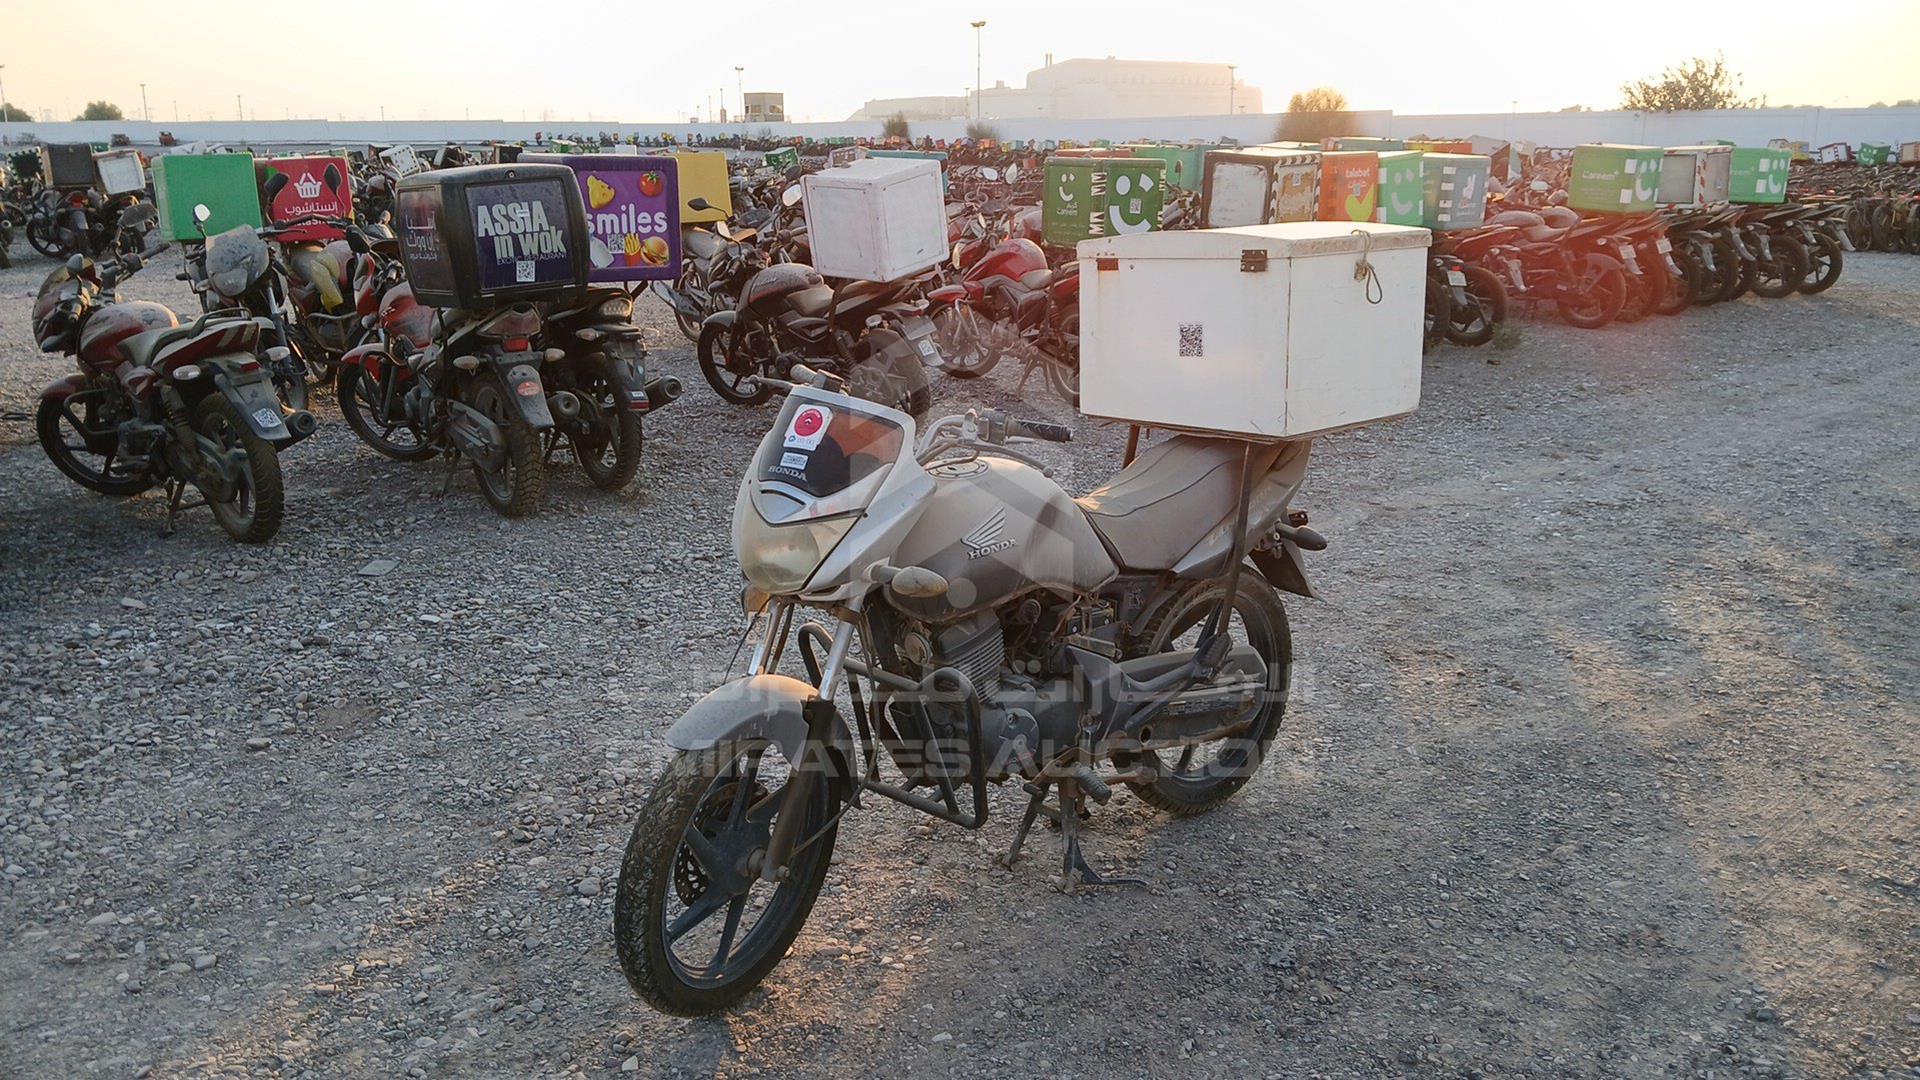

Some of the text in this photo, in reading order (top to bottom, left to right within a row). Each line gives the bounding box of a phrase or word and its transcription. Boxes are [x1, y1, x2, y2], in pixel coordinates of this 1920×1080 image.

[477, 201, 549, 237] ASSIA
[585, 203, 668, 235] smiles
[493, 235, 515, 259] in
[768, 465, 808, 482] HONDA
[967, 538, 1017, 560] HONDA
